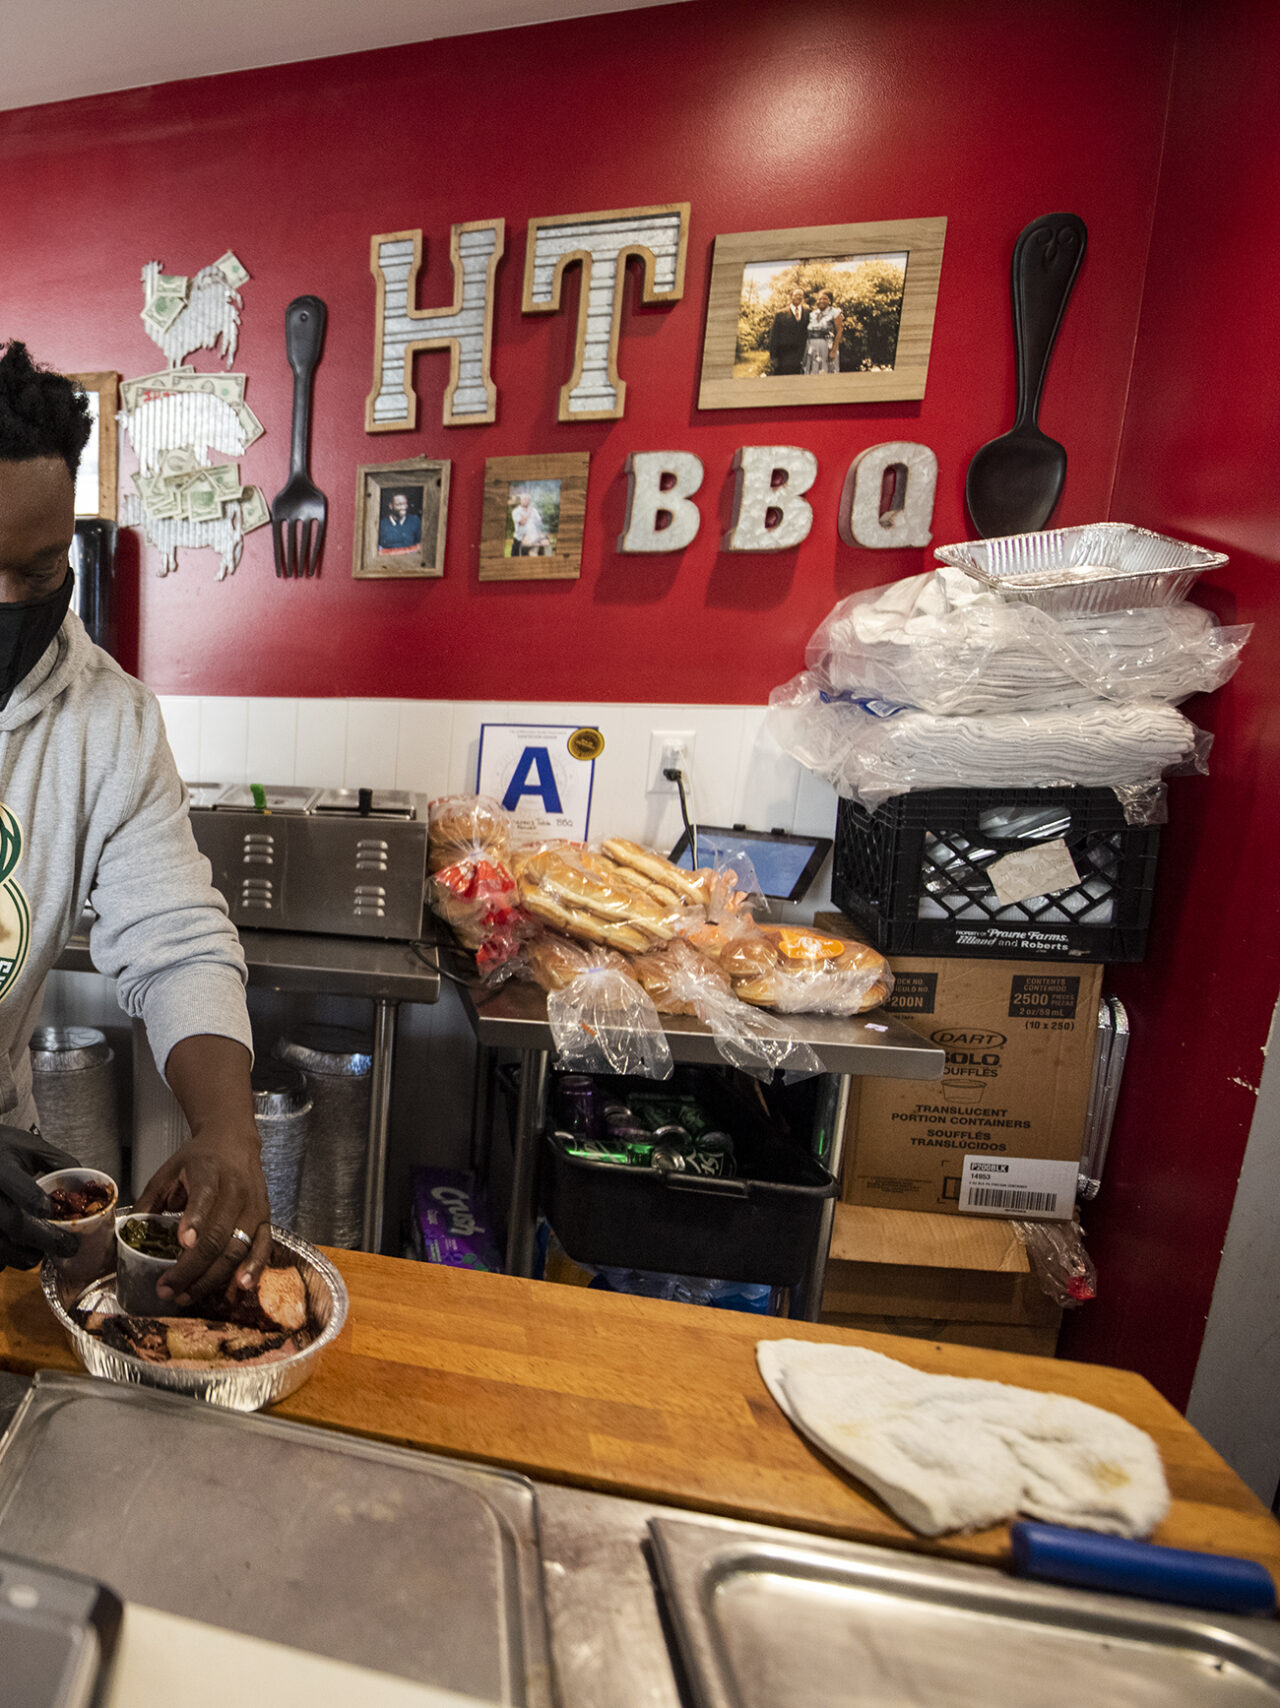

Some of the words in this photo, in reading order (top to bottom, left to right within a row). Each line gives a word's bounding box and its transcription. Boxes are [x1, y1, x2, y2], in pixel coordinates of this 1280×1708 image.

[365, 202, 691, 432] HT
[617, 441, 938, 554] BBQ
[501, 746, 563, 814] A
[998, 940, 1018, 948] and
[1021, 940, 1069, 951] Roberts
[1023, 984, 1067, 992] CONTENIDO
[1013, 993, 1048, 1006] 2500
[1025, 1021, 1041, 1031] (10
[1051, 1021, 1075, 1032] 250)
[939, 1033, 997, 1045] DART
[916, 1104, 1008, 1117] TRANSLUCENT
[891, 1112, 946, 1124] PORTION
[950, 1117, 1031, 1129] CONTAINERS
[927, 1128, 991, 1141] SOUFFLÉS
[910, 1137, 1007, 1151] TRANSLÚCIDOS
[431, 1187, 485, 1236] Crush
